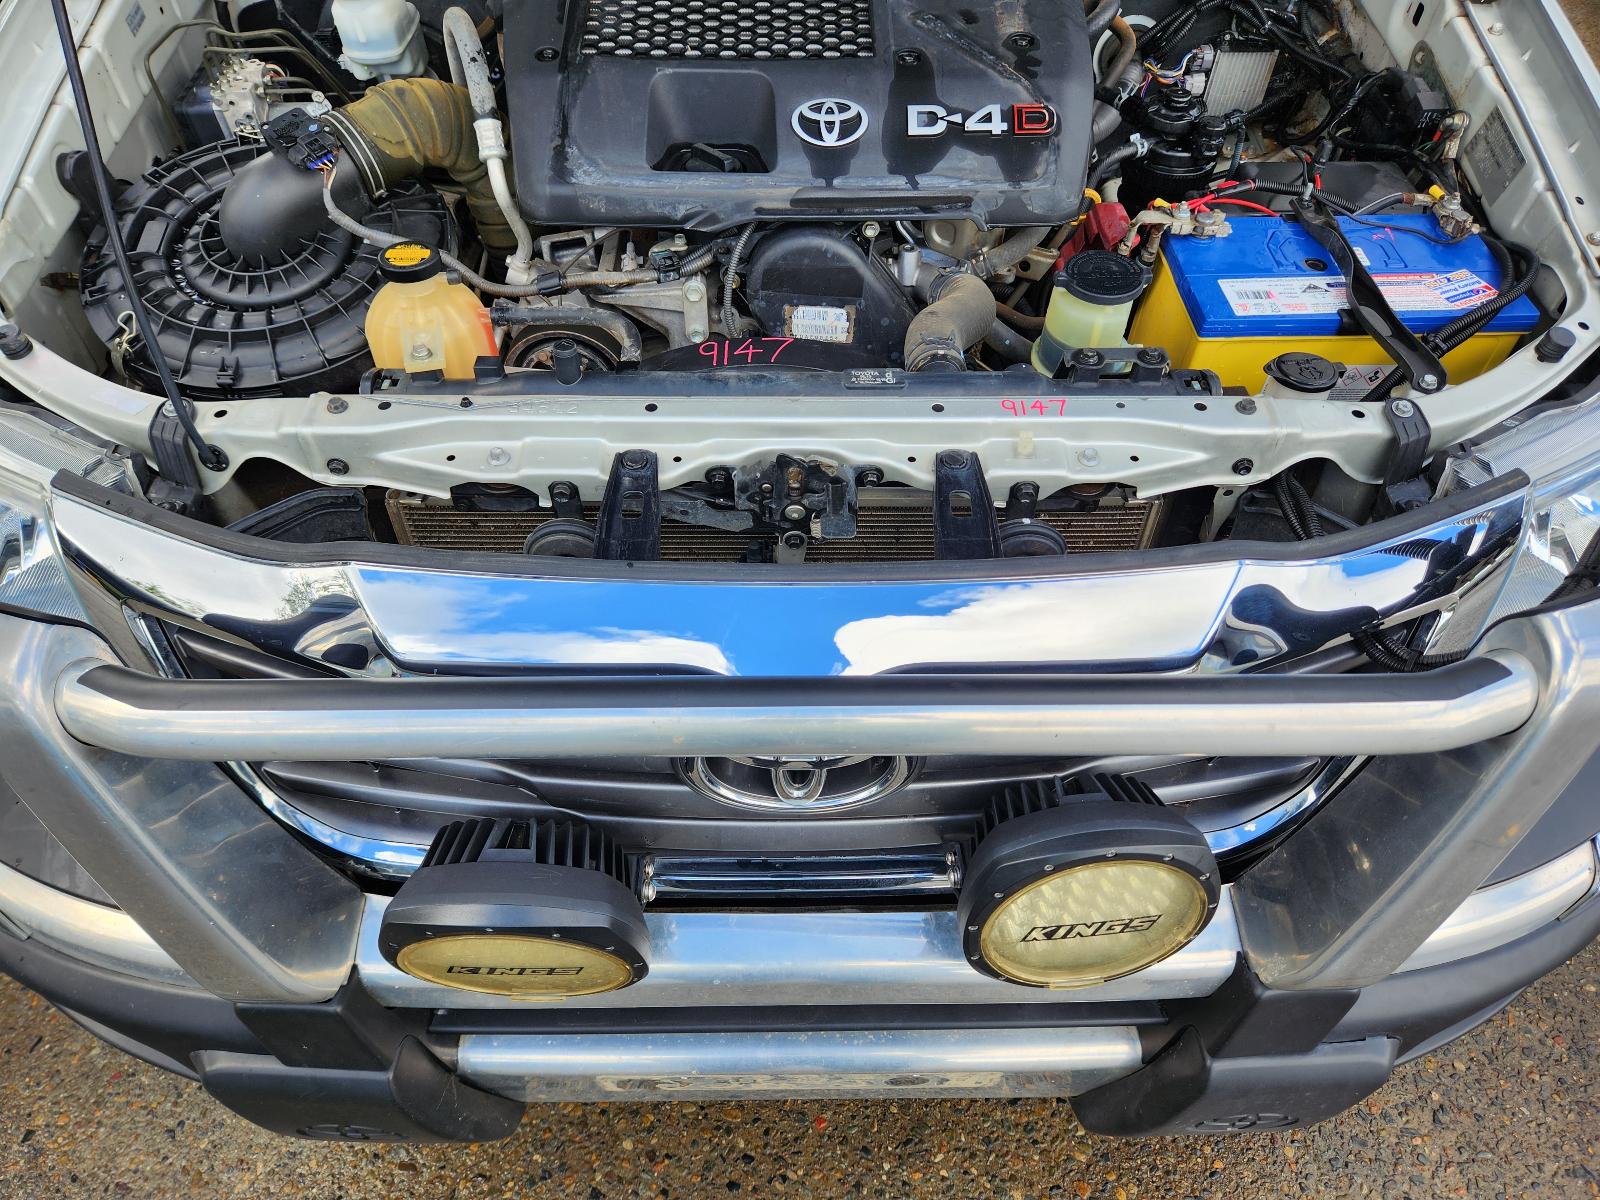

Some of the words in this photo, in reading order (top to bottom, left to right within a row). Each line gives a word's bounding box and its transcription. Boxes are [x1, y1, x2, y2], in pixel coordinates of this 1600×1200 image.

[907, 104, 1057, 135] D-4D
[698, 337, 795, 366] 9147
[1000, 399, 1067, 417] 9147
[1020, 913, 1164, 943] KINGS
[446, 965, 585, 976] KINGS
